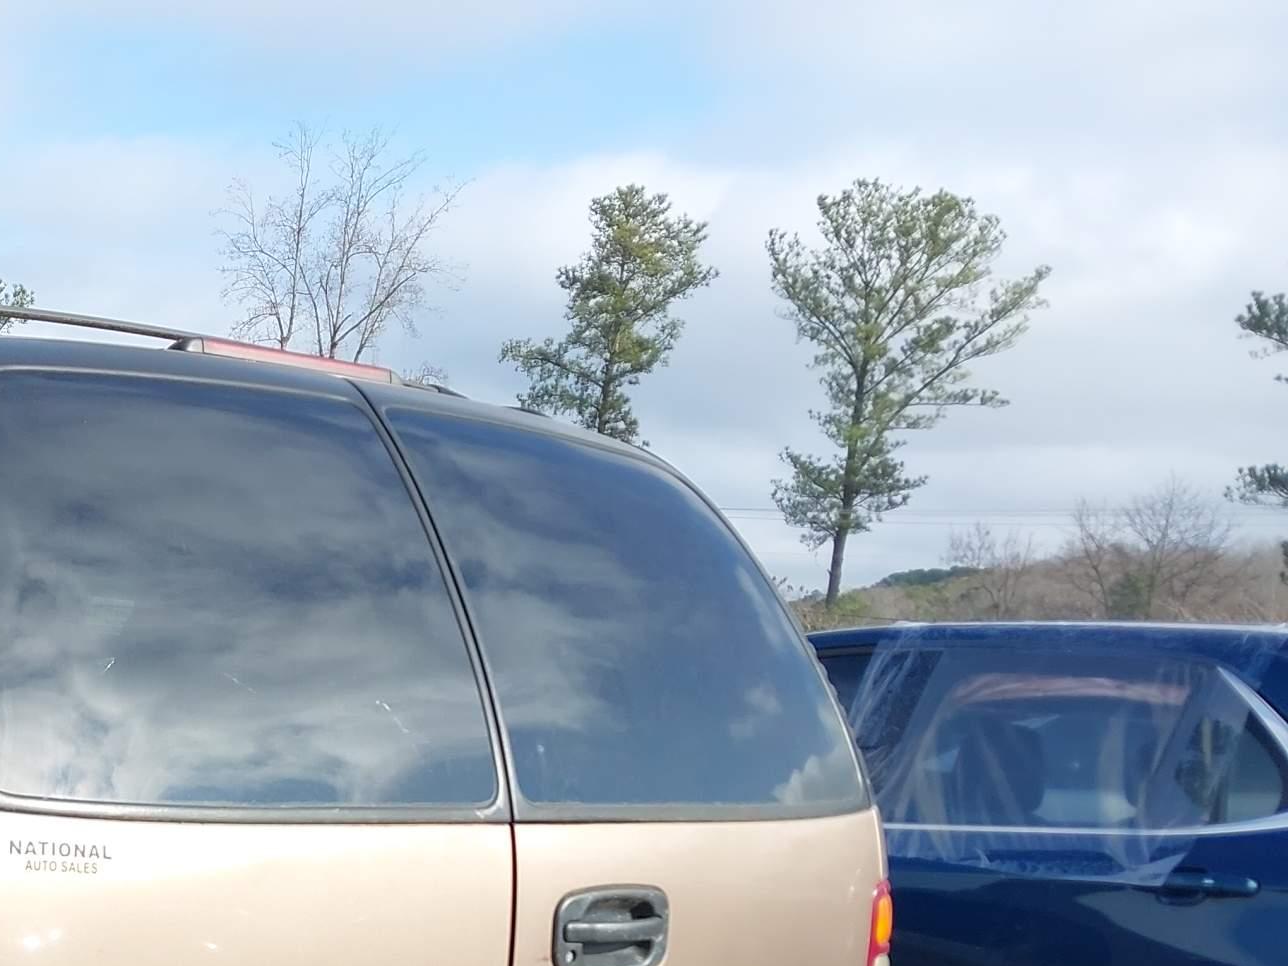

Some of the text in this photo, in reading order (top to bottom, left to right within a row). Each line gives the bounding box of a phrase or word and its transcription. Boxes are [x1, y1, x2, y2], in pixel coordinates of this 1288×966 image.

[9, 841, 112, 860] NATIONAL
[25, 860, 98, 874] AUTO SALES
